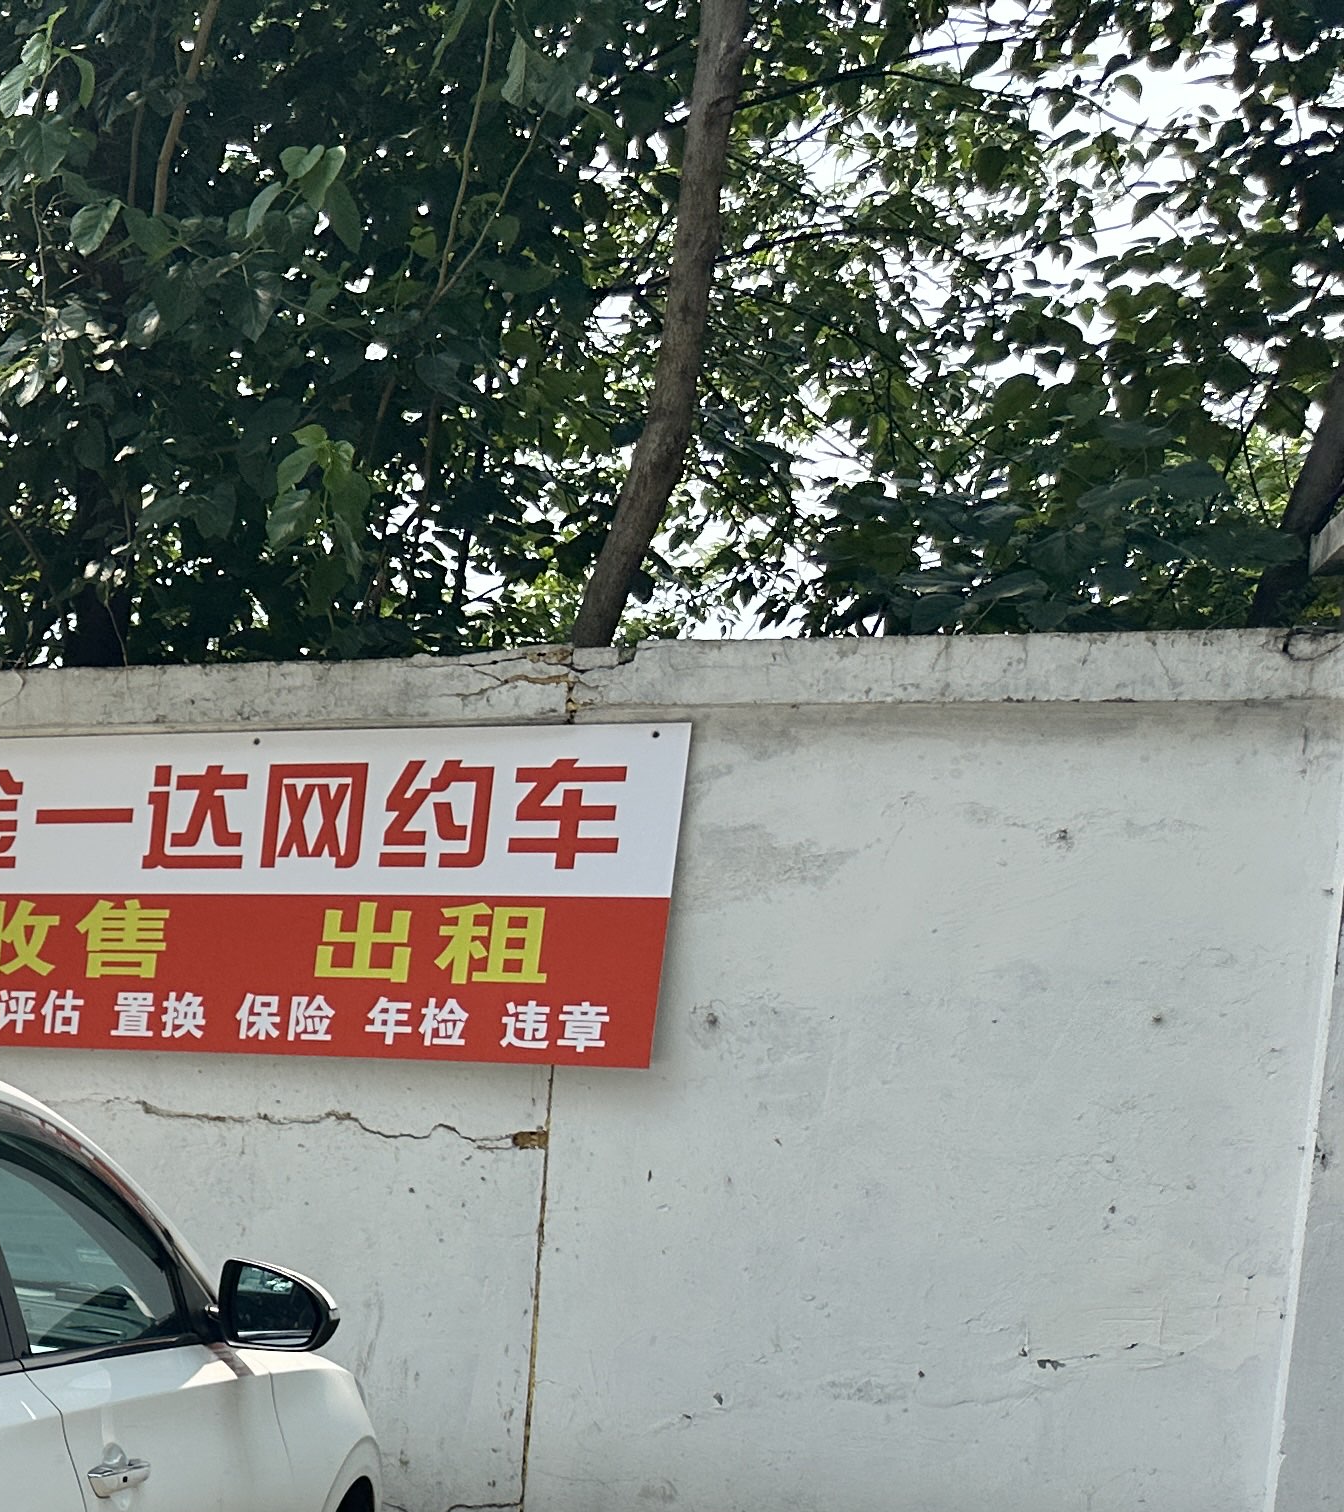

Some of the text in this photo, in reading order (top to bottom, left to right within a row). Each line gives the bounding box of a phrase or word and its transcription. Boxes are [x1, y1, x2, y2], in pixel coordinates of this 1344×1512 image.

[314, 901, 548, 985] 出租
[109, 990, 208, 1040] 置换
[234, 991, 337, 1043] 保险
[363, 994, 471, 1048] 年检
[498, 998, 611, 1054] 违章
